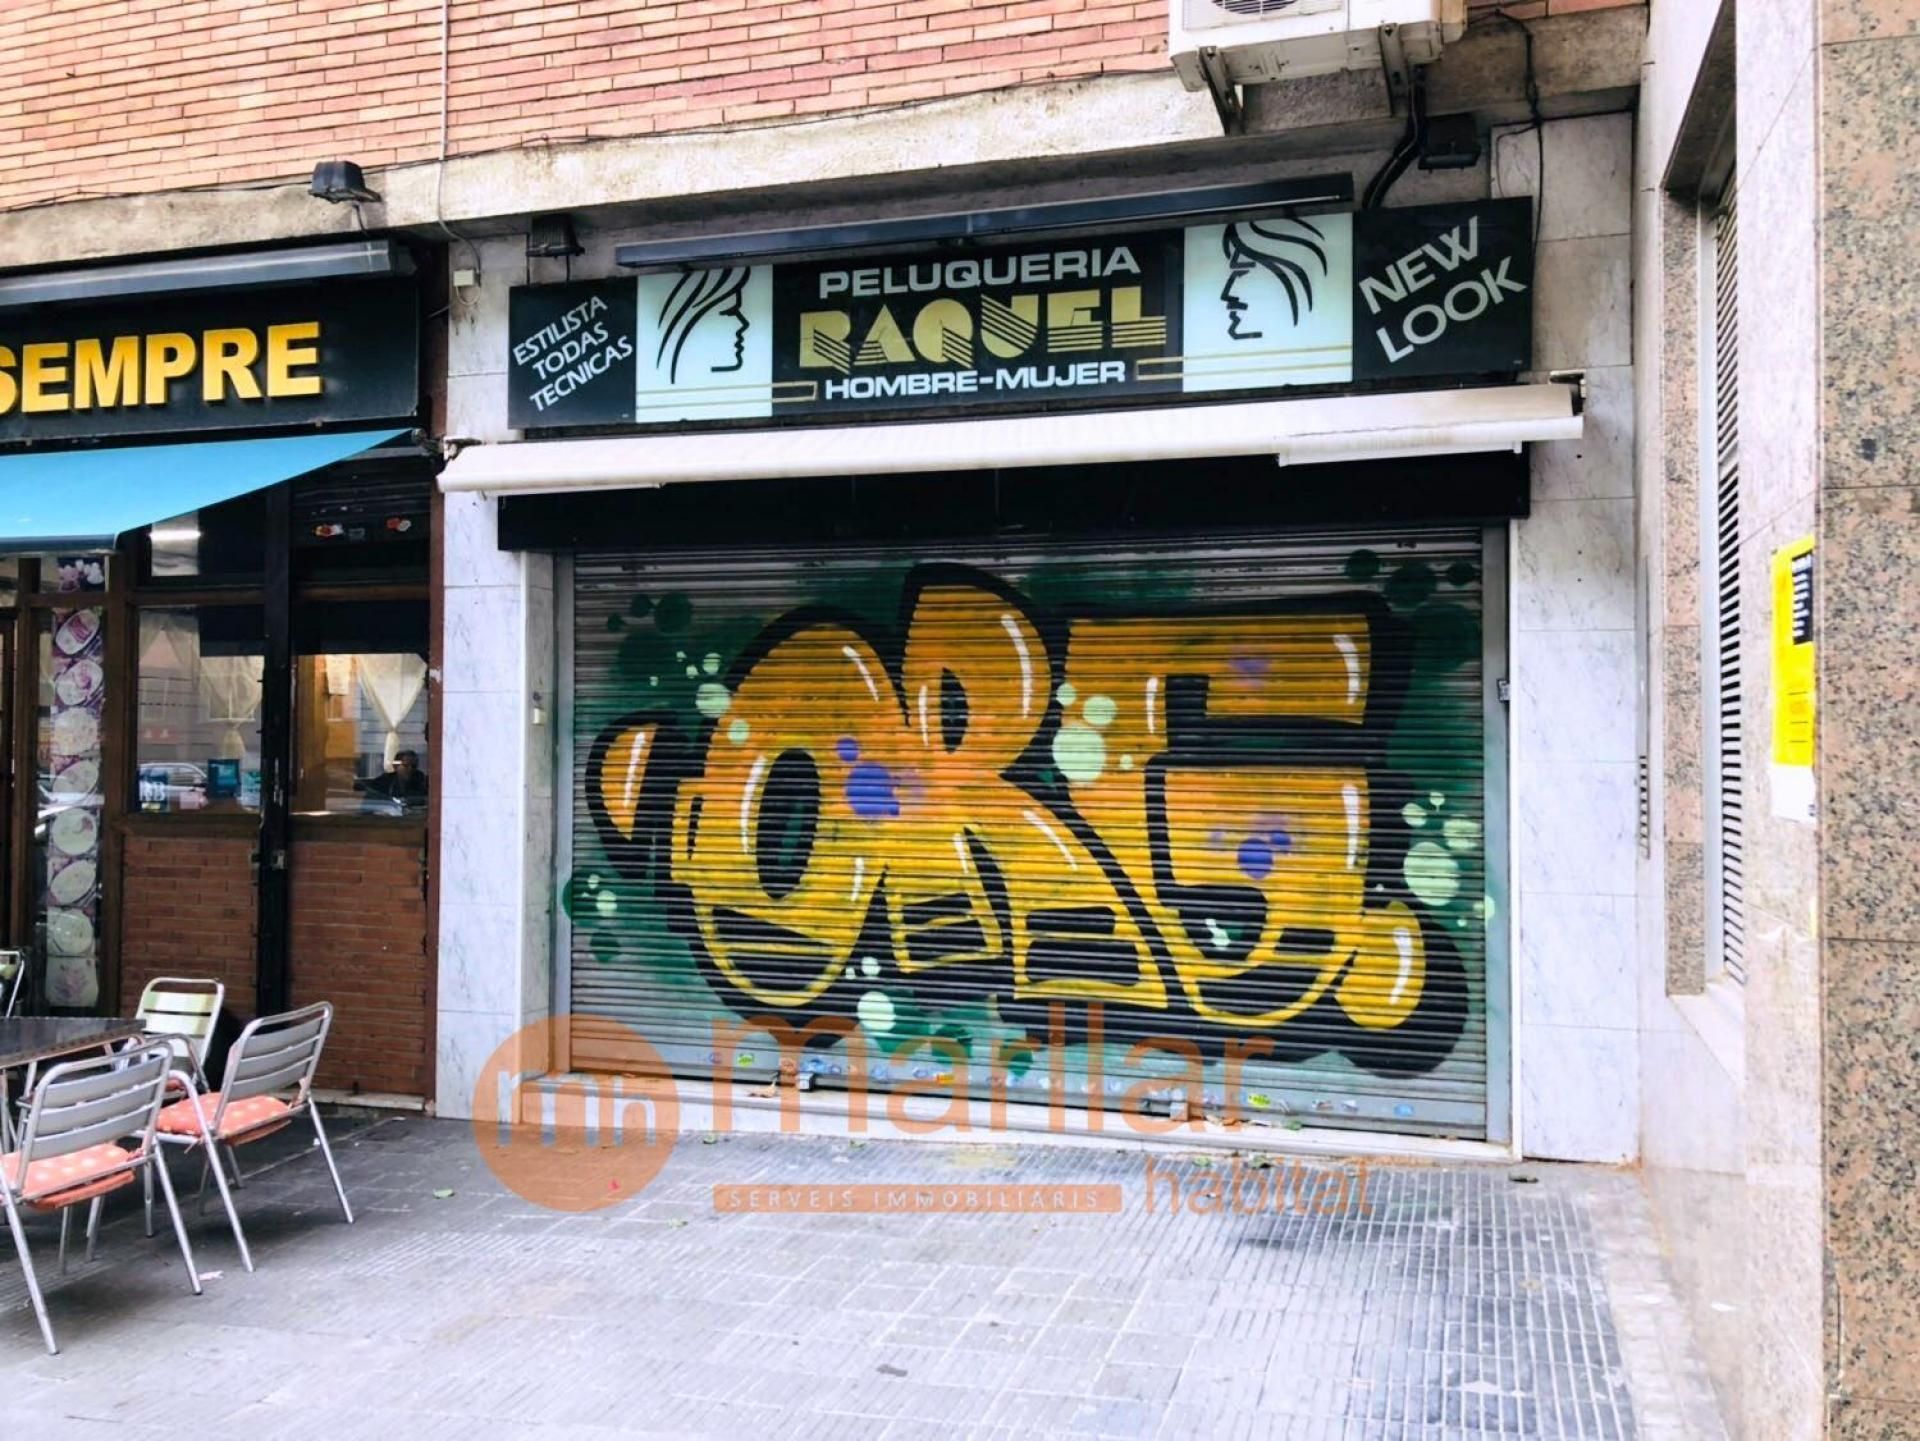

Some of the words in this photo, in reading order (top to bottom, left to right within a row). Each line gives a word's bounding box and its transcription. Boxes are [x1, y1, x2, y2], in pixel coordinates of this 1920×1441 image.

[819, 247, 1141, 299] PELUQUERIA
[1359, 215, 1478, 315] NEW
[513, 295, 608, 366] ESTILISTA
[799, 285, 1167, 375] RAQUEL
[1376, 256, 1527, 363] LOOK
[529, 335, 634, 412] TECNICAS
[532, 322, 609, 380] TODAS
[825, 361, 1125, 400] HOMBRE-MUJER
